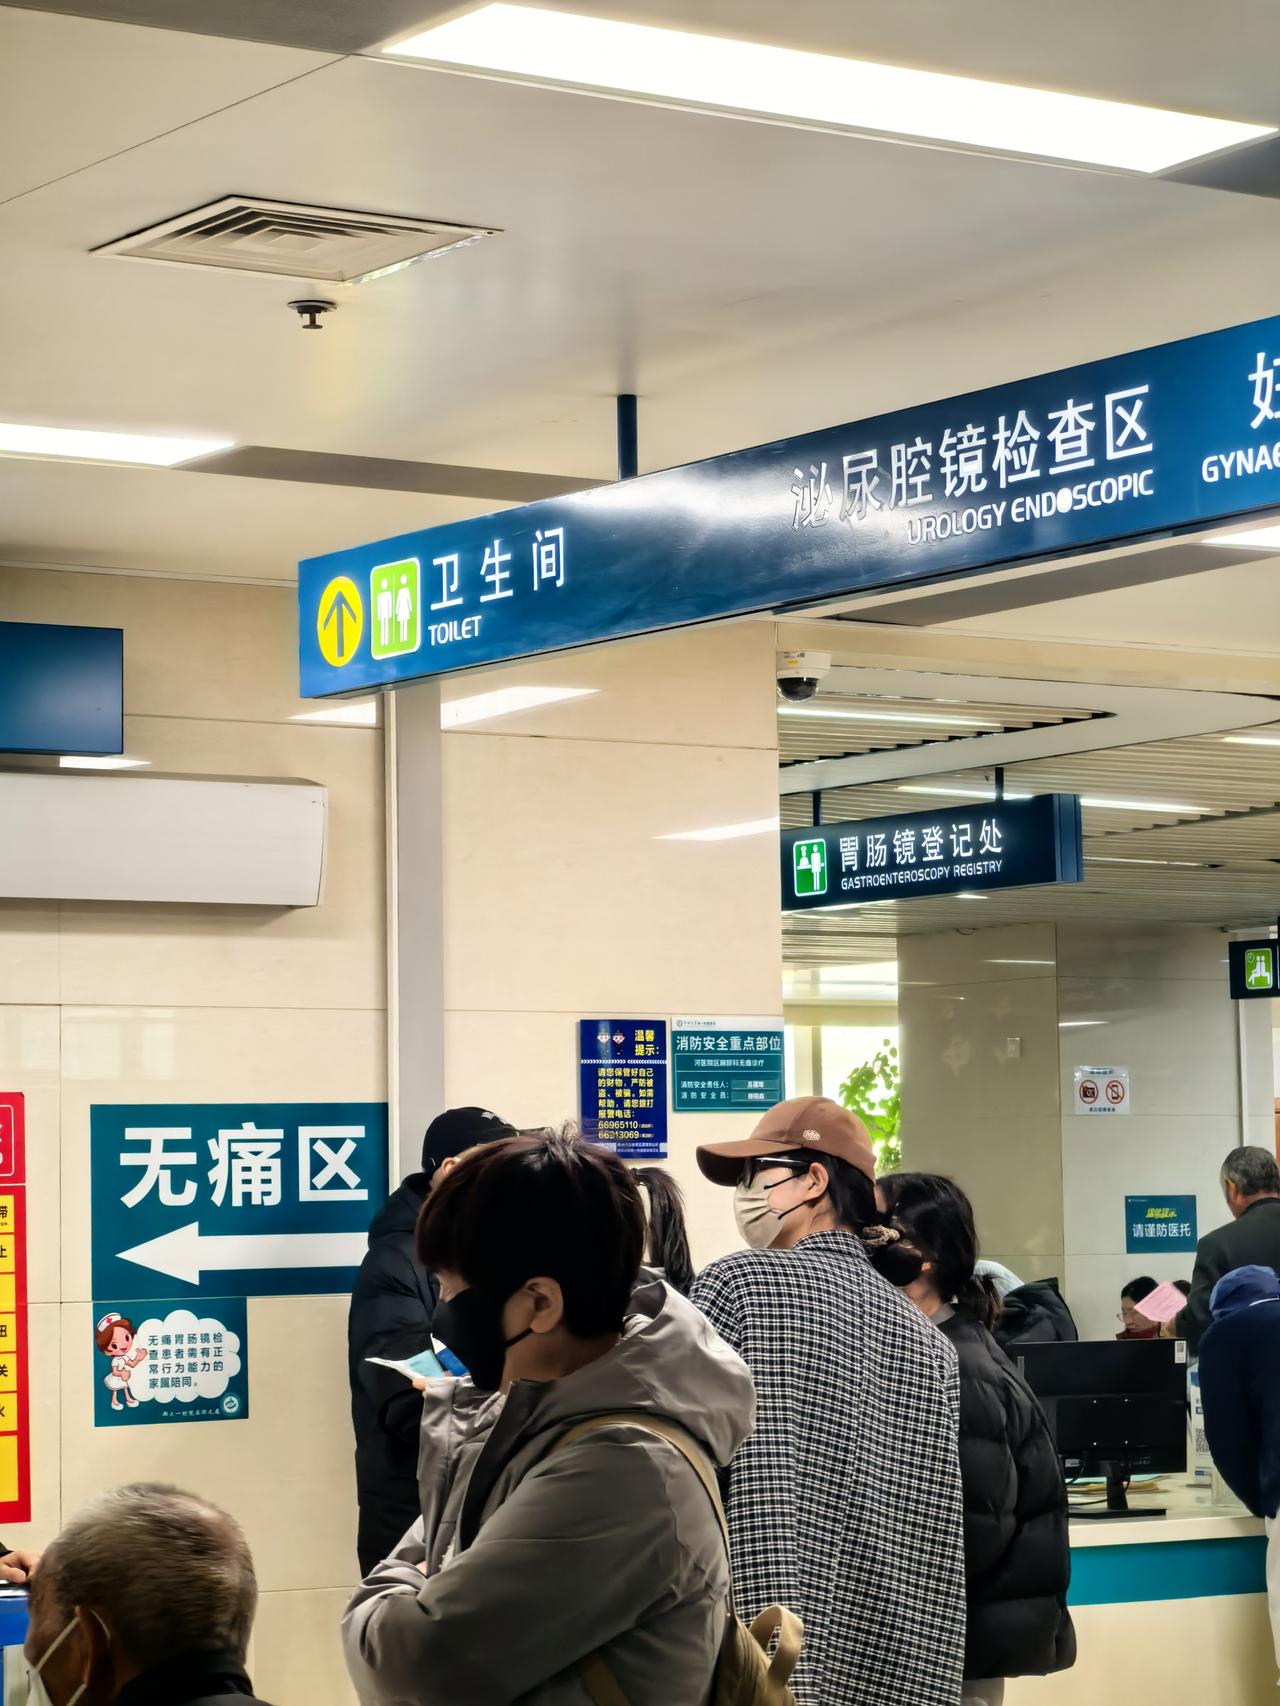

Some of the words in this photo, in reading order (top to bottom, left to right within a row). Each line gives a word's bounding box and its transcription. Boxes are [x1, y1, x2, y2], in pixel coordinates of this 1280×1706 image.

[790, 383, 1153, 531] 泌尿腔镜检查区
[907, 500, 1005, 545] UROLOGY
[1011, 469, 1154, 523] ENDOSCOPIC
[430, 526, 565, 611] 卫生间
[428, 615, 482, 646] TOILET
[839, 818, 1003, 873] 胃肠镜登记处
[841, 866, 950, 890] GASTROENTEROSCOPY
[953, 859, 1003, 878] REGISTRY
[634, 1029, 655, 1042] 温馨
[676, 1035, 782, 1051] 消防安全重点部位
[634, 1043, 659, 1056] 提示：
[597, 1067, 654, 1077] 请您保管好自己
[598, 1120, 638, 1129] 66965110
[119, 1121, 369, 1209] 无痛区
[1132, 1223, 1191, 1238] 请谨防医托
[148, 1331, 223, 1346] 无痛胃肠镜检
[148, 1346, 223, 1361] 查患者需有正
[148, 1360, 224, 1374] 常行为能力的
